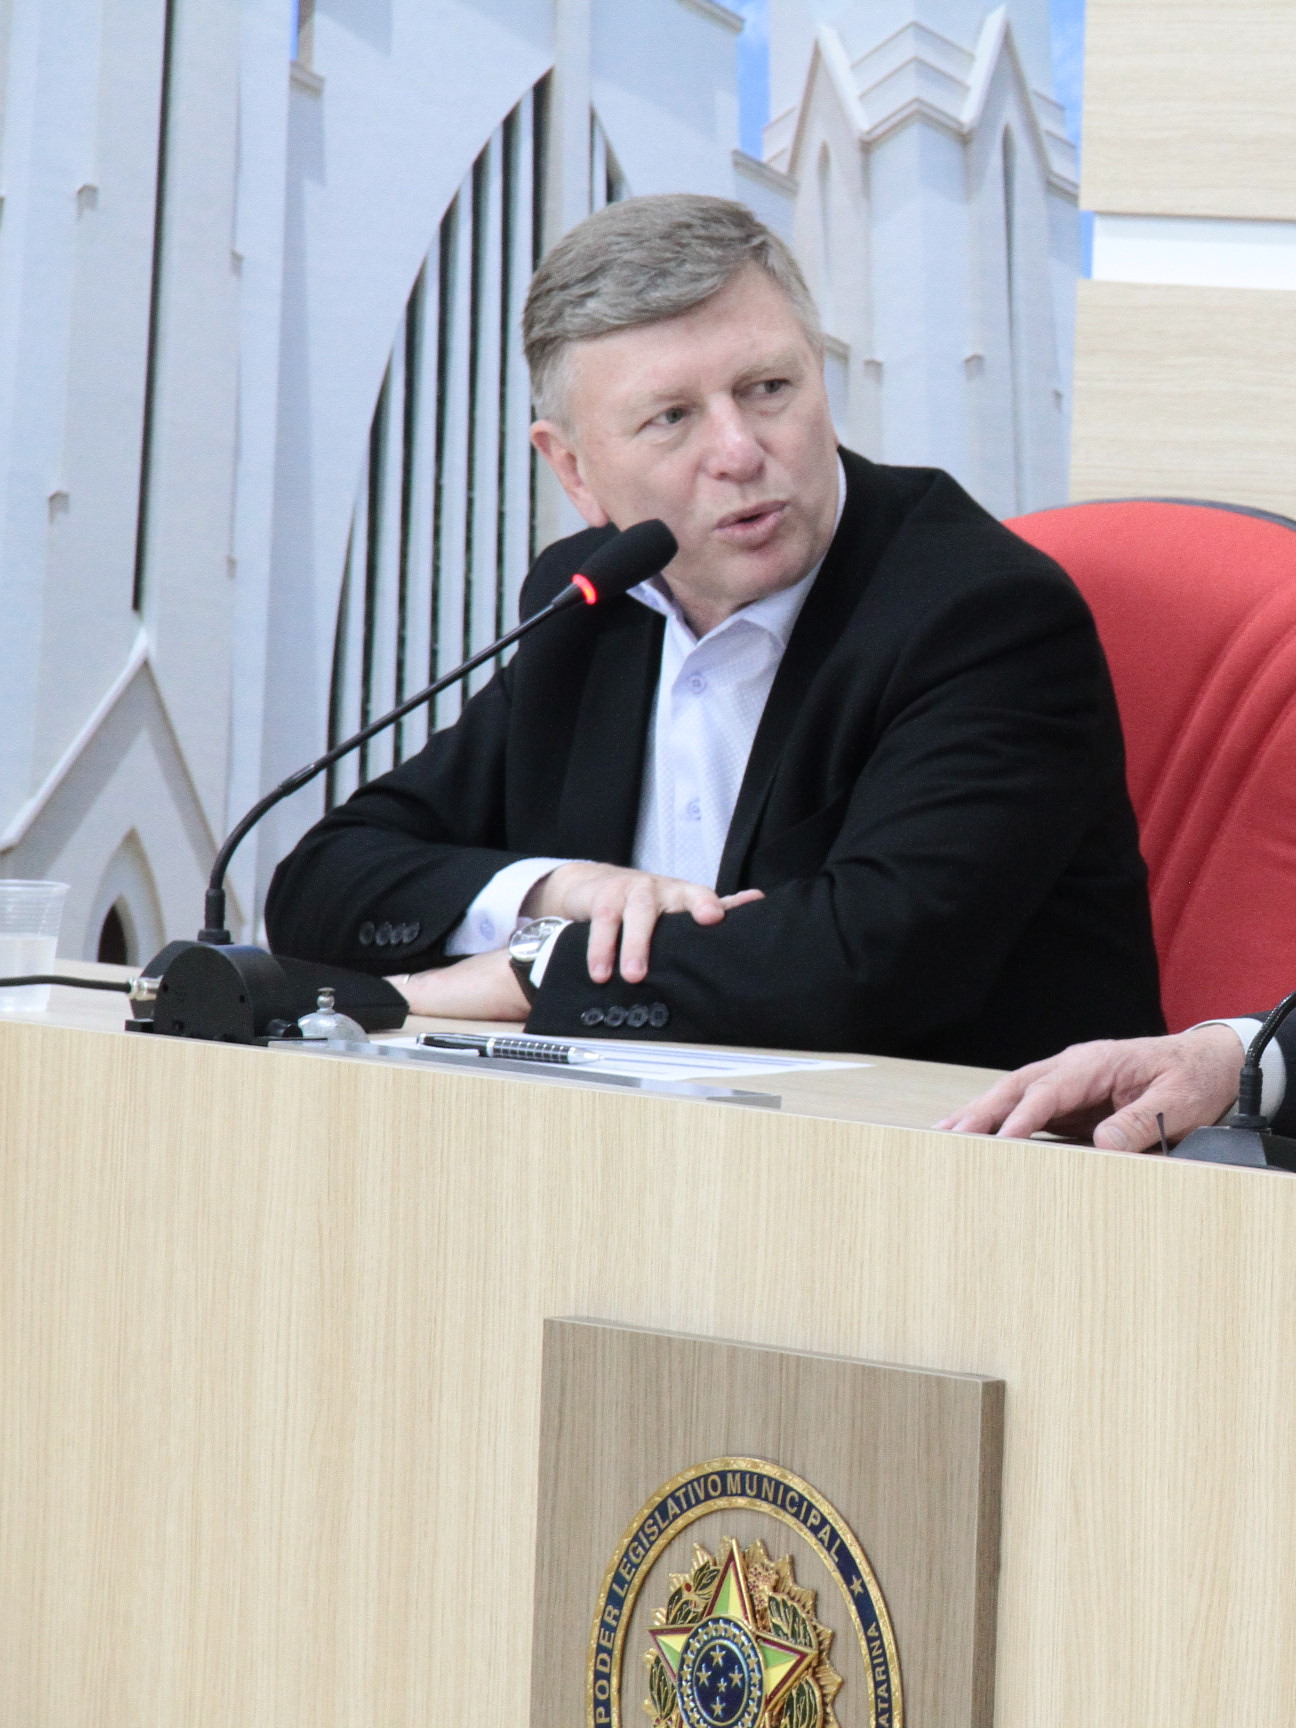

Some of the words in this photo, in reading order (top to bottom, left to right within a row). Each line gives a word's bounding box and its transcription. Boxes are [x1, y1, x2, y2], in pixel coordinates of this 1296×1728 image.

[595, 1605, 620, 1724] PODER
[613, 1474, 722, 1598] LEGISLATIVO
[726, 1472, 839, 1563] MUNICIPAL
